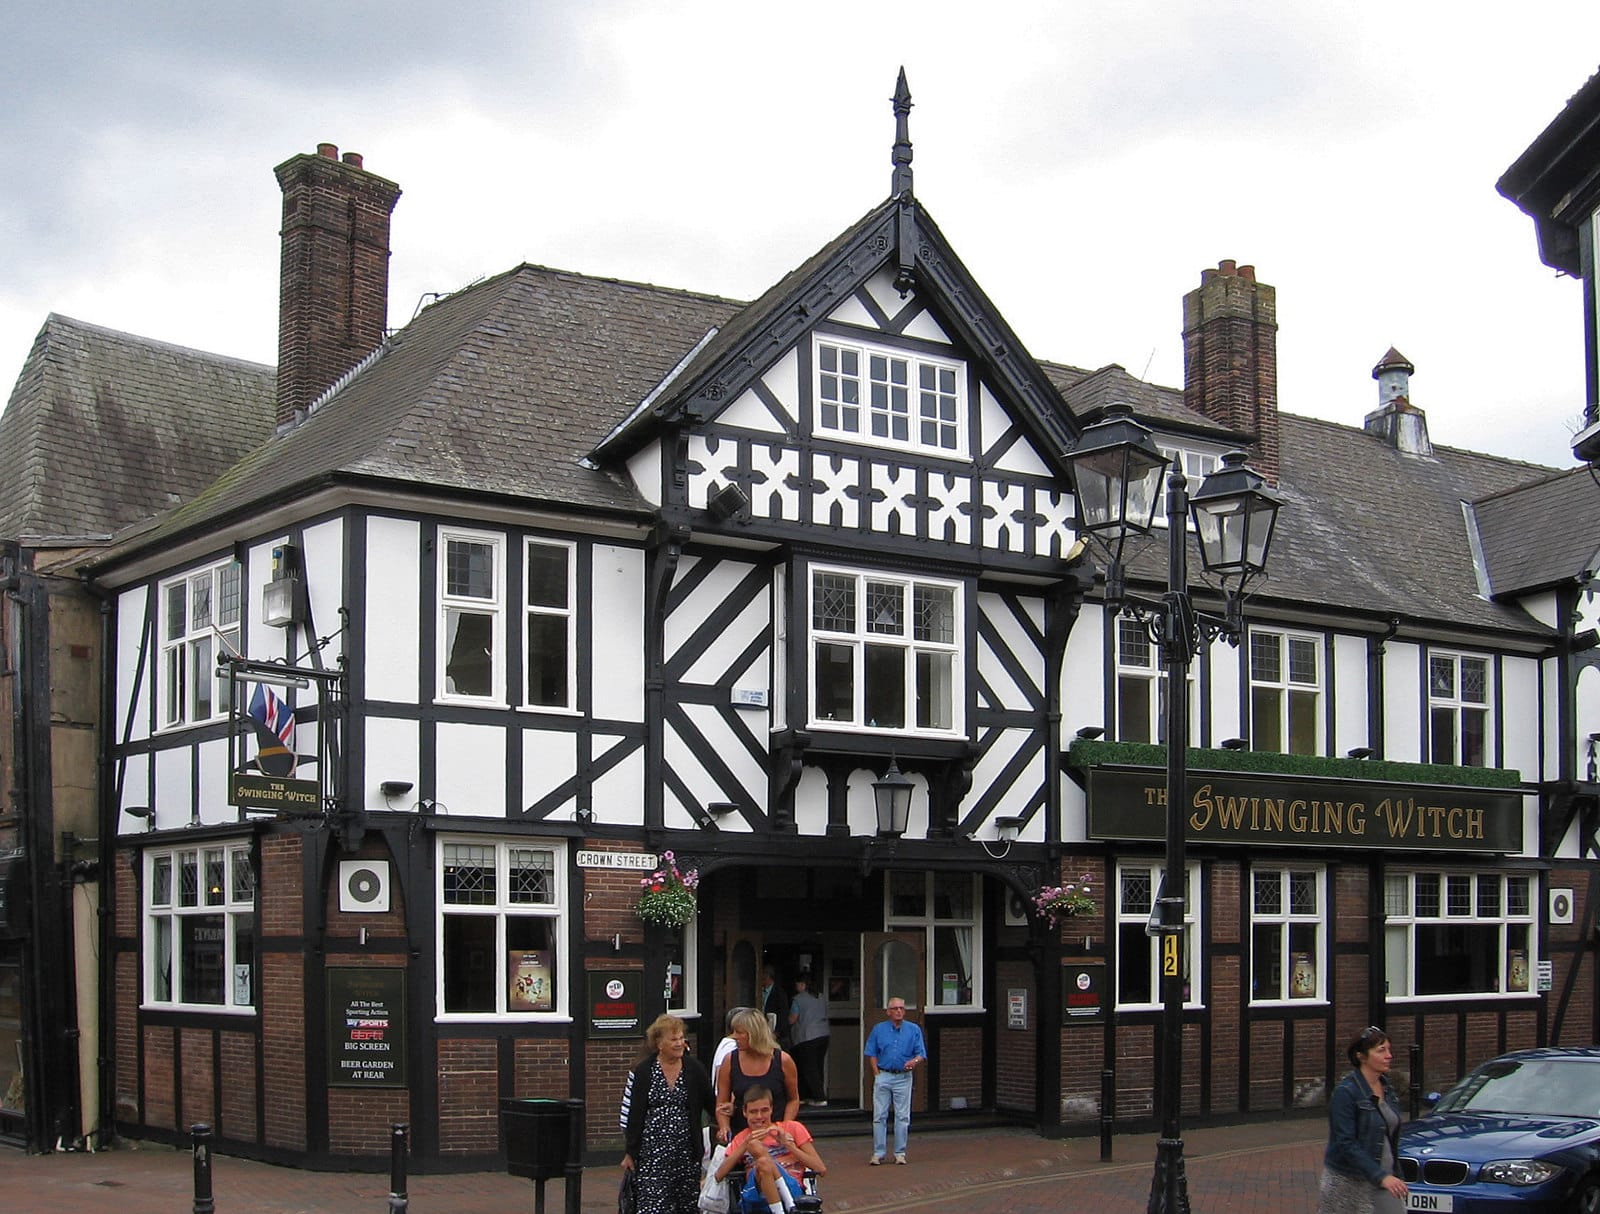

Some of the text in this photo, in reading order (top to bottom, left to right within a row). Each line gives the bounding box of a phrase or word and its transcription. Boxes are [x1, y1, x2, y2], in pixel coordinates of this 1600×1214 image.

[238, 786, 316, 802] SWINGING WITCH
[1144, 784, 1484, 839] TH SWINGING WITCH
[580, 853, 655, 868] CROWN STREET
[344, 1042, 390, 1051] BIG SCREEN
[340, 1060, 394, 1069] BEER GARDEN
[352, 1071, 385, 1079] AT REAR
